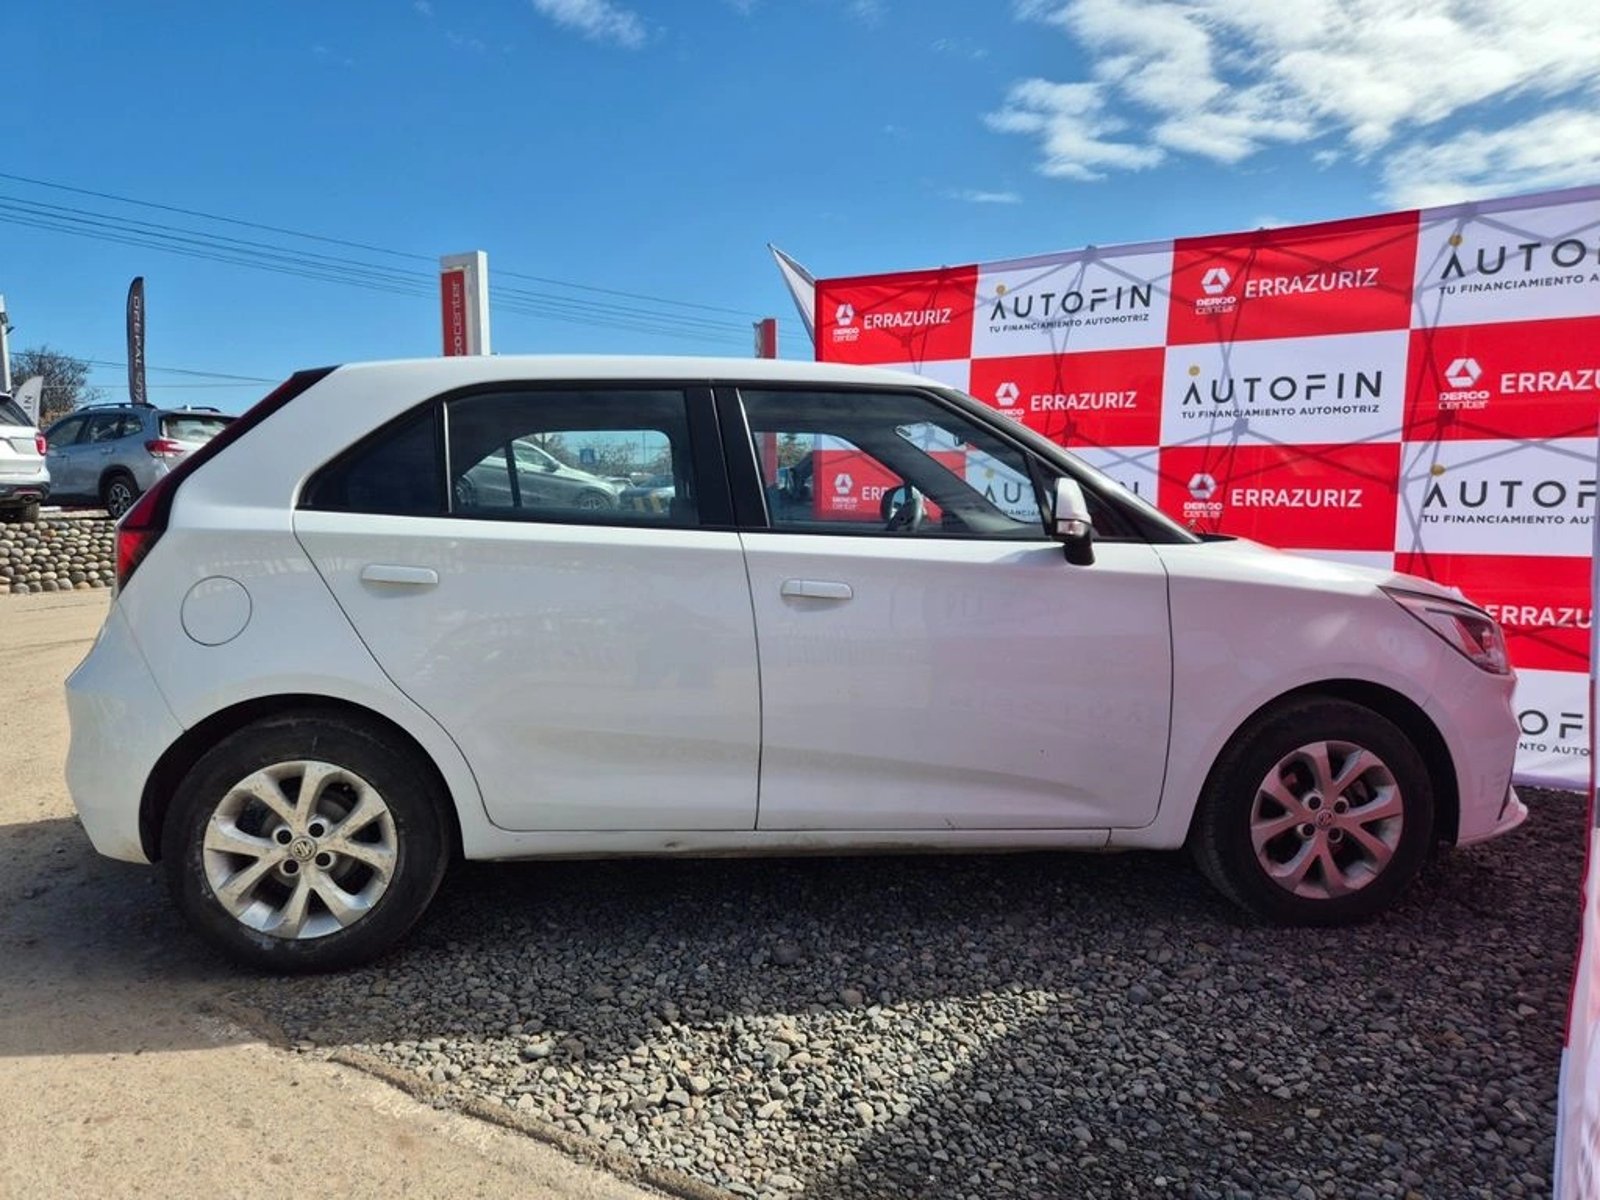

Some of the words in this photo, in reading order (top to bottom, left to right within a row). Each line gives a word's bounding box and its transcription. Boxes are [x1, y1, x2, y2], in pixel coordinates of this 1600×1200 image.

[1441, 238, 1600, 279] AUTO
[1245, 267, 1380, 298] ERRAZURIZ
[1439, 286, 1455, 294] TU
[1460, 274, 1584, 293] FINANCIAMIENTO
[990, 284, 1152, 320] AUTOFIN
[863, 308, 952, 330] ERRAZURIZ
[1003, 319, 1082, 332] FINANCIAMIENTO
[1085, 313, 1149, 326] AUTOMOTRIZ
[1182, 371, 1382, 405] AUTOFIN
[1439, 390, 1490, 400] DERCO
[1030, 391, 1137, 411] ERRAZURIZ
[1182, 411, 1195, 419] TU
[1198, 407, 1296, 418] FINANCIAMIENTO
[1300, 404, 1380, 416] AUTOMOTRIZ
[1231, 489, 1363, 508] ERRAZURIZ
[1422, 515, 1438, 523] TU
[1443, 514, 1565, 525] FINANCIAMIENTO
